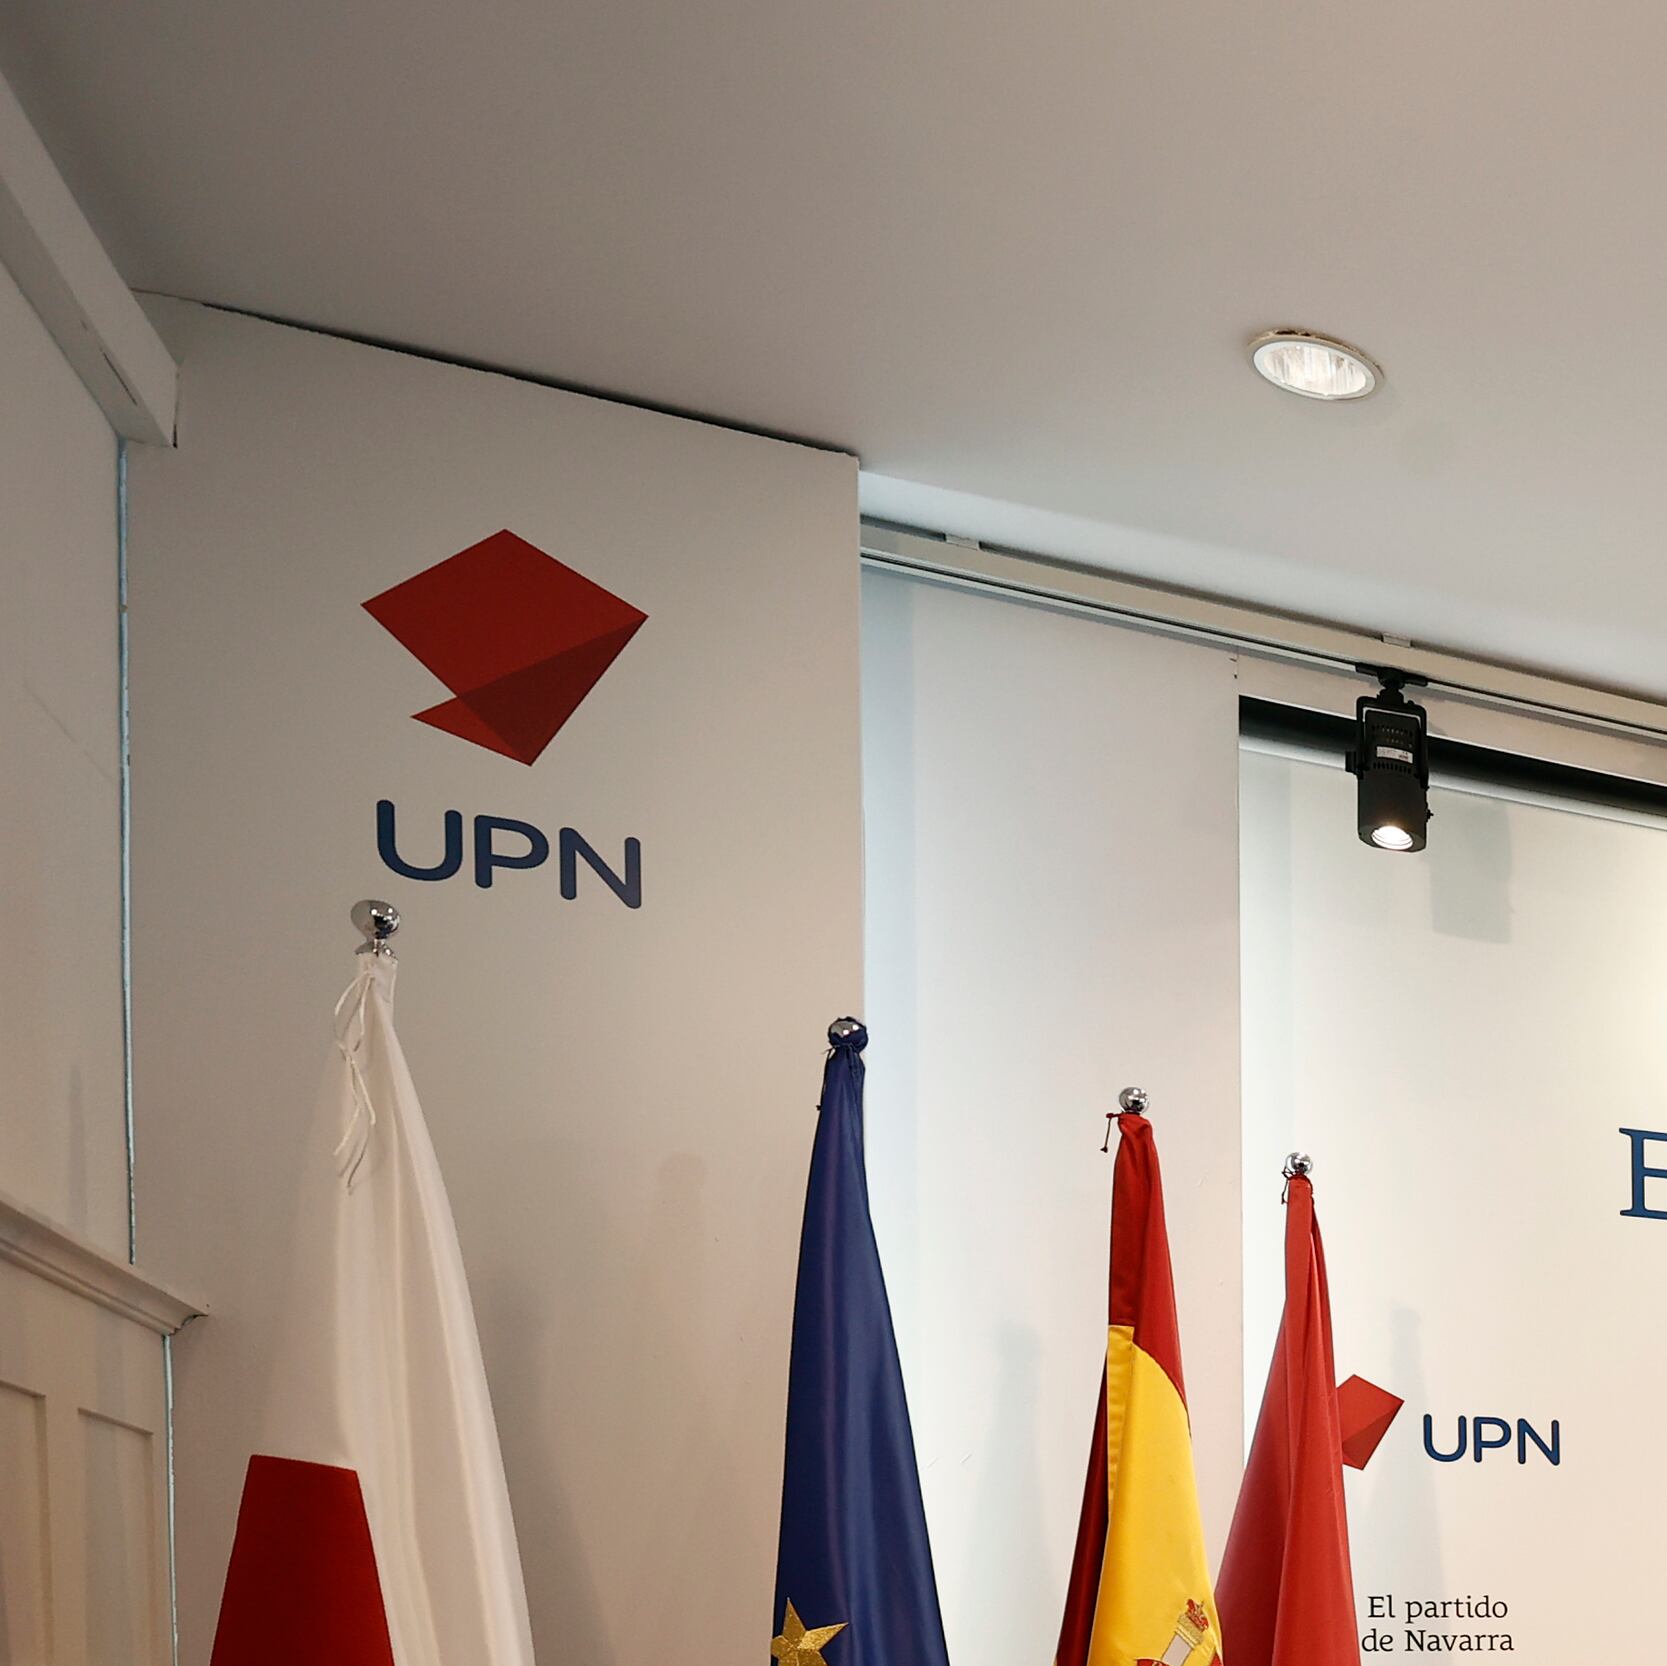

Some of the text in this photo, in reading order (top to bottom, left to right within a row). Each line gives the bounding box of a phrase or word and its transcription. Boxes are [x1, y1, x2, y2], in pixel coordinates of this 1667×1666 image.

[376, 800, 641, 909] UPN
[1423, 1414, 1560, 1466] UPN
[1368, 1595, 1507, 1624] El partido
[1362, 1629, 1514, 1652] de Navarra
